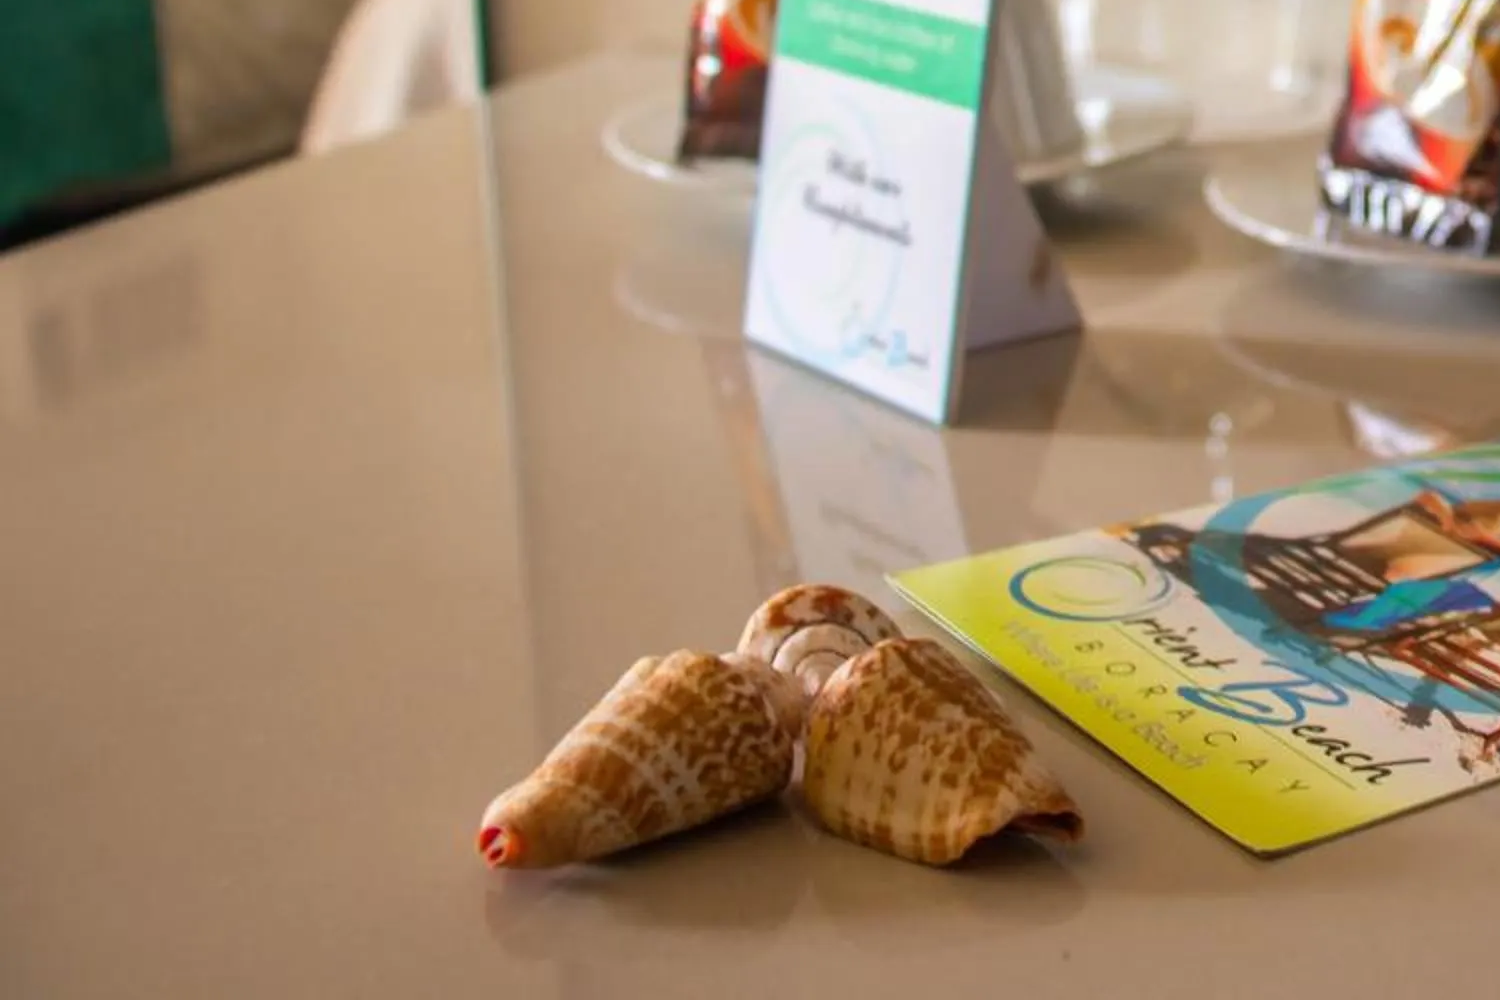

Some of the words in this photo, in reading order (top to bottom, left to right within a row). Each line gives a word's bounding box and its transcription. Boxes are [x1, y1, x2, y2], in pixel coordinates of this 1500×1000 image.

[1007, 556, 1238, 672] Orient
[1175, 659, 1432, 787] Beach
[1074, 640, 1311, 796] BORACAY
